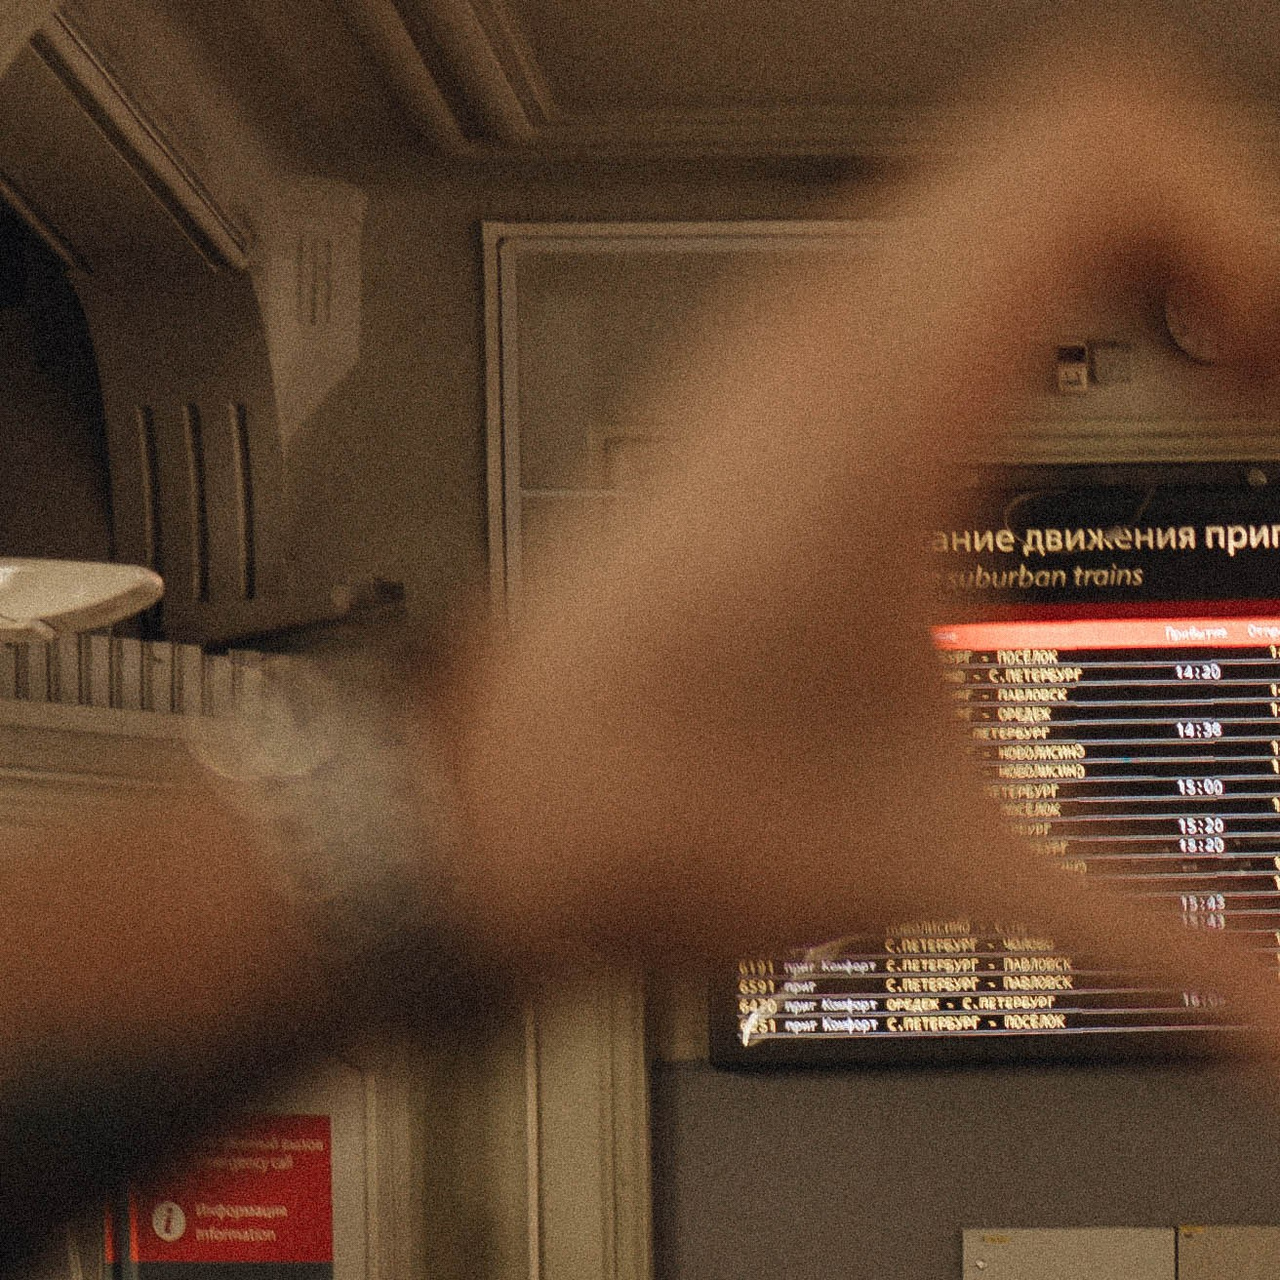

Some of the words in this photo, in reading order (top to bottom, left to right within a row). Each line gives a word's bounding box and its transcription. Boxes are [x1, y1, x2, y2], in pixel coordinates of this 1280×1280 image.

[1022, 524, 1195, 557] движения
[942, 564, 1066, 589] suburban
[1075, 563, 1144, 588] trains
